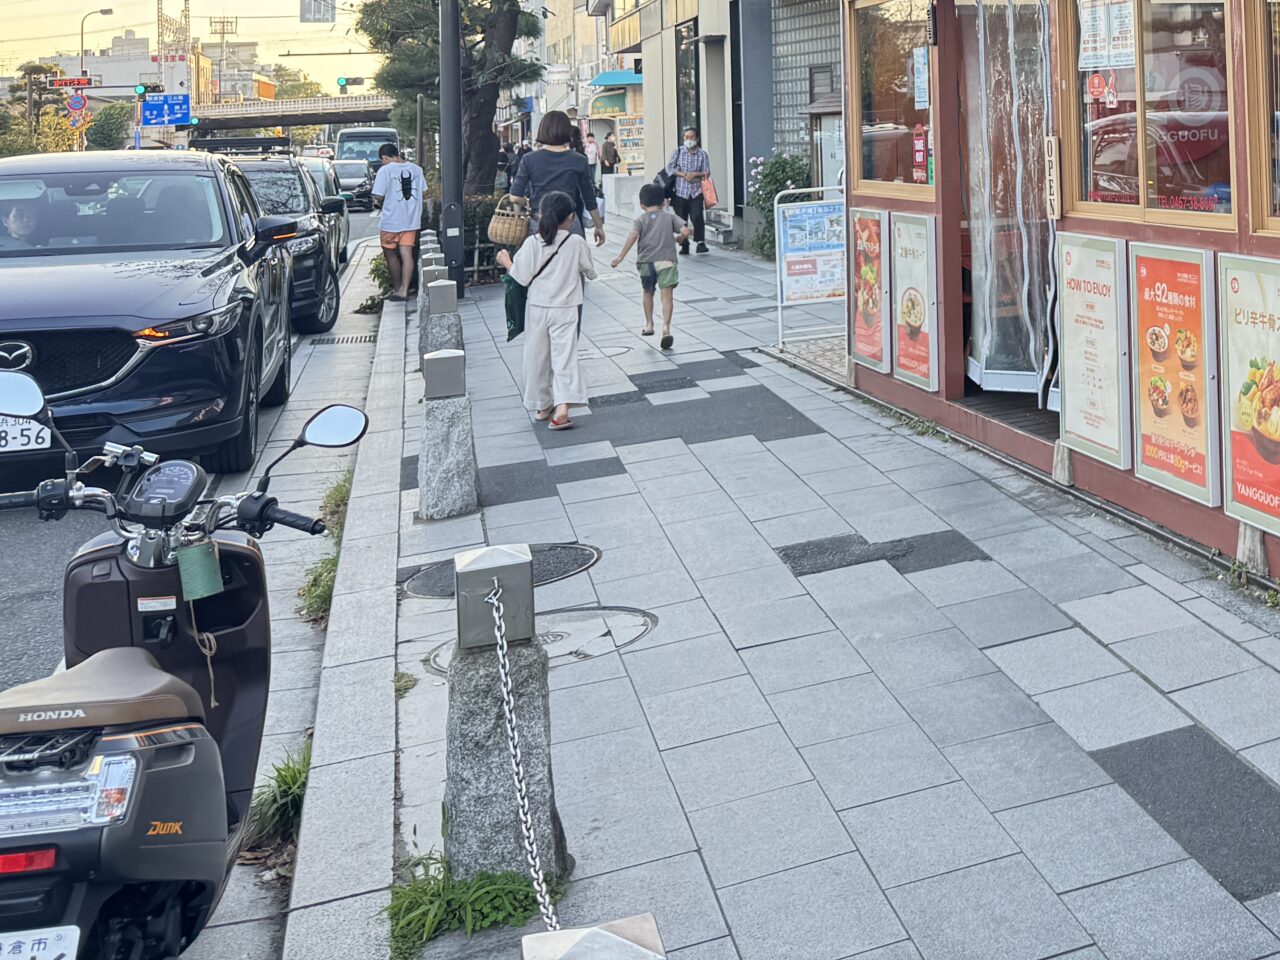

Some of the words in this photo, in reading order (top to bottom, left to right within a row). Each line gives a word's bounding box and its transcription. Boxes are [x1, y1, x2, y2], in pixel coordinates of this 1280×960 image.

[1047, 140, 1055, 216] OPEN
[1159, 195, 1169, 208] TEL
[1066, 277, 1082, 293] HOW
[1083, 281, 1092, 294] TO
[1093, 282, 1112, 298] ENJOY
[11, 417, 31, 427] 304
[18, 708, 86, 722] HONDA
[0, 937, 48, 955] 倉市
